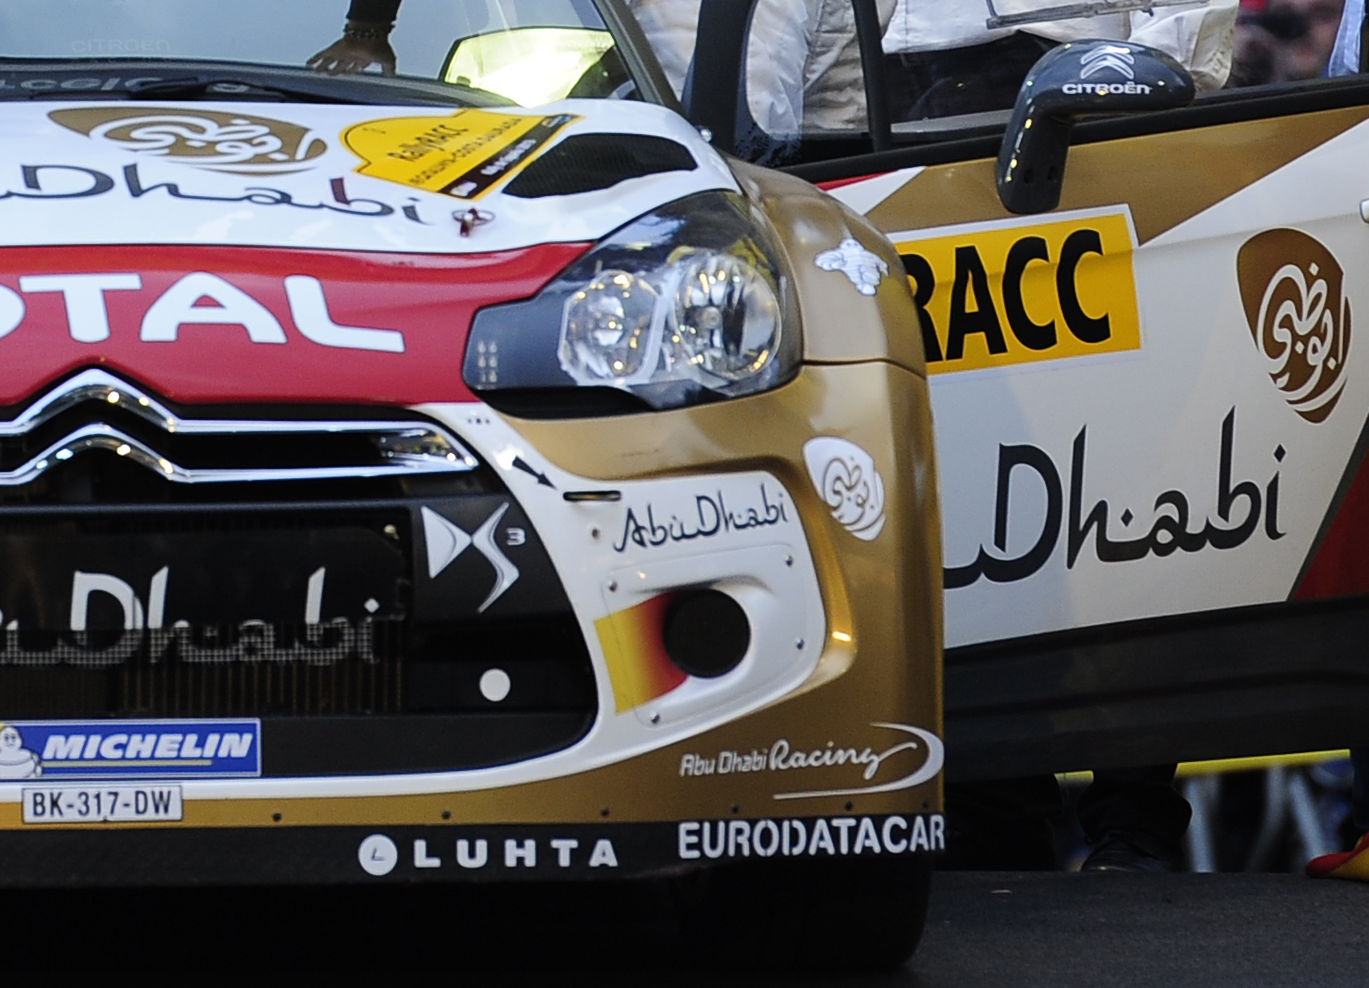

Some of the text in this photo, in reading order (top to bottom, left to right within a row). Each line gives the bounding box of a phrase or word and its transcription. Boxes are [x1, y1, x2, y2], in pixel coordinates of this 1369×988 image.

[895, 229, 1112, 364] RACC
[42, 733, 253, 760] MICHELIN
[680, 739, 918, 781] Abu Dhabi Racing
[32, 790, 173, 818] BK-317-DW
[413, 838, 619, 869] LUHTA
[678, 815, 946, 860] EURODATACAR
